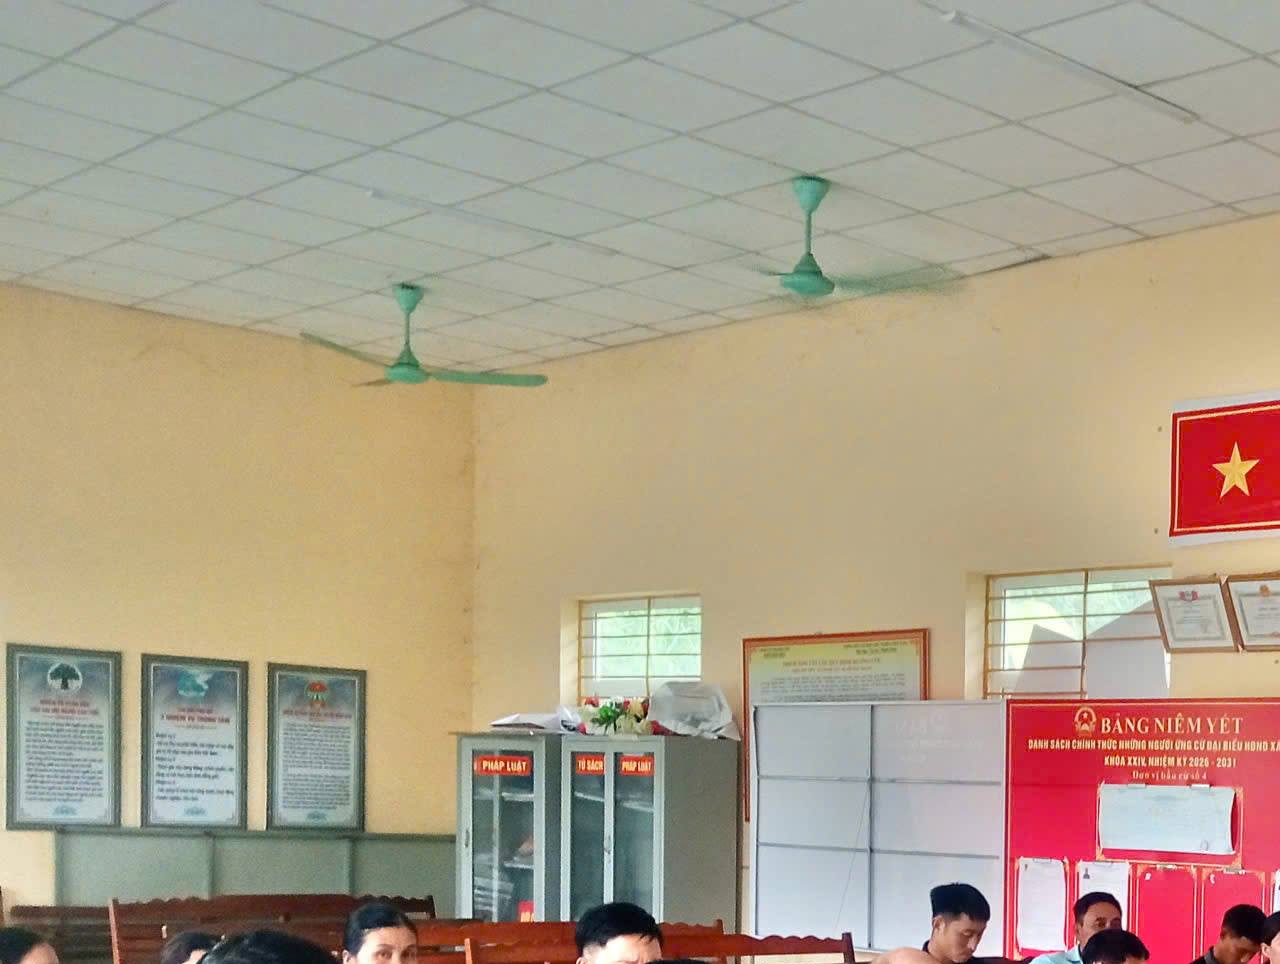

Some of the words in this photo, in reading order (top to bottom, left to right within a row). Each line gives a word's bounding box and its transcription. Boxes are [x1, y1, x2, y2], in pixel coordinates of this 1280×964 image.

[1101, 712, 1149, 735] BẢNG
[1154, 712, 1201, 735] NIÊM
[1028, 739, 1049, 750] DANH
[506, 759, 527, 773] LUẬT
